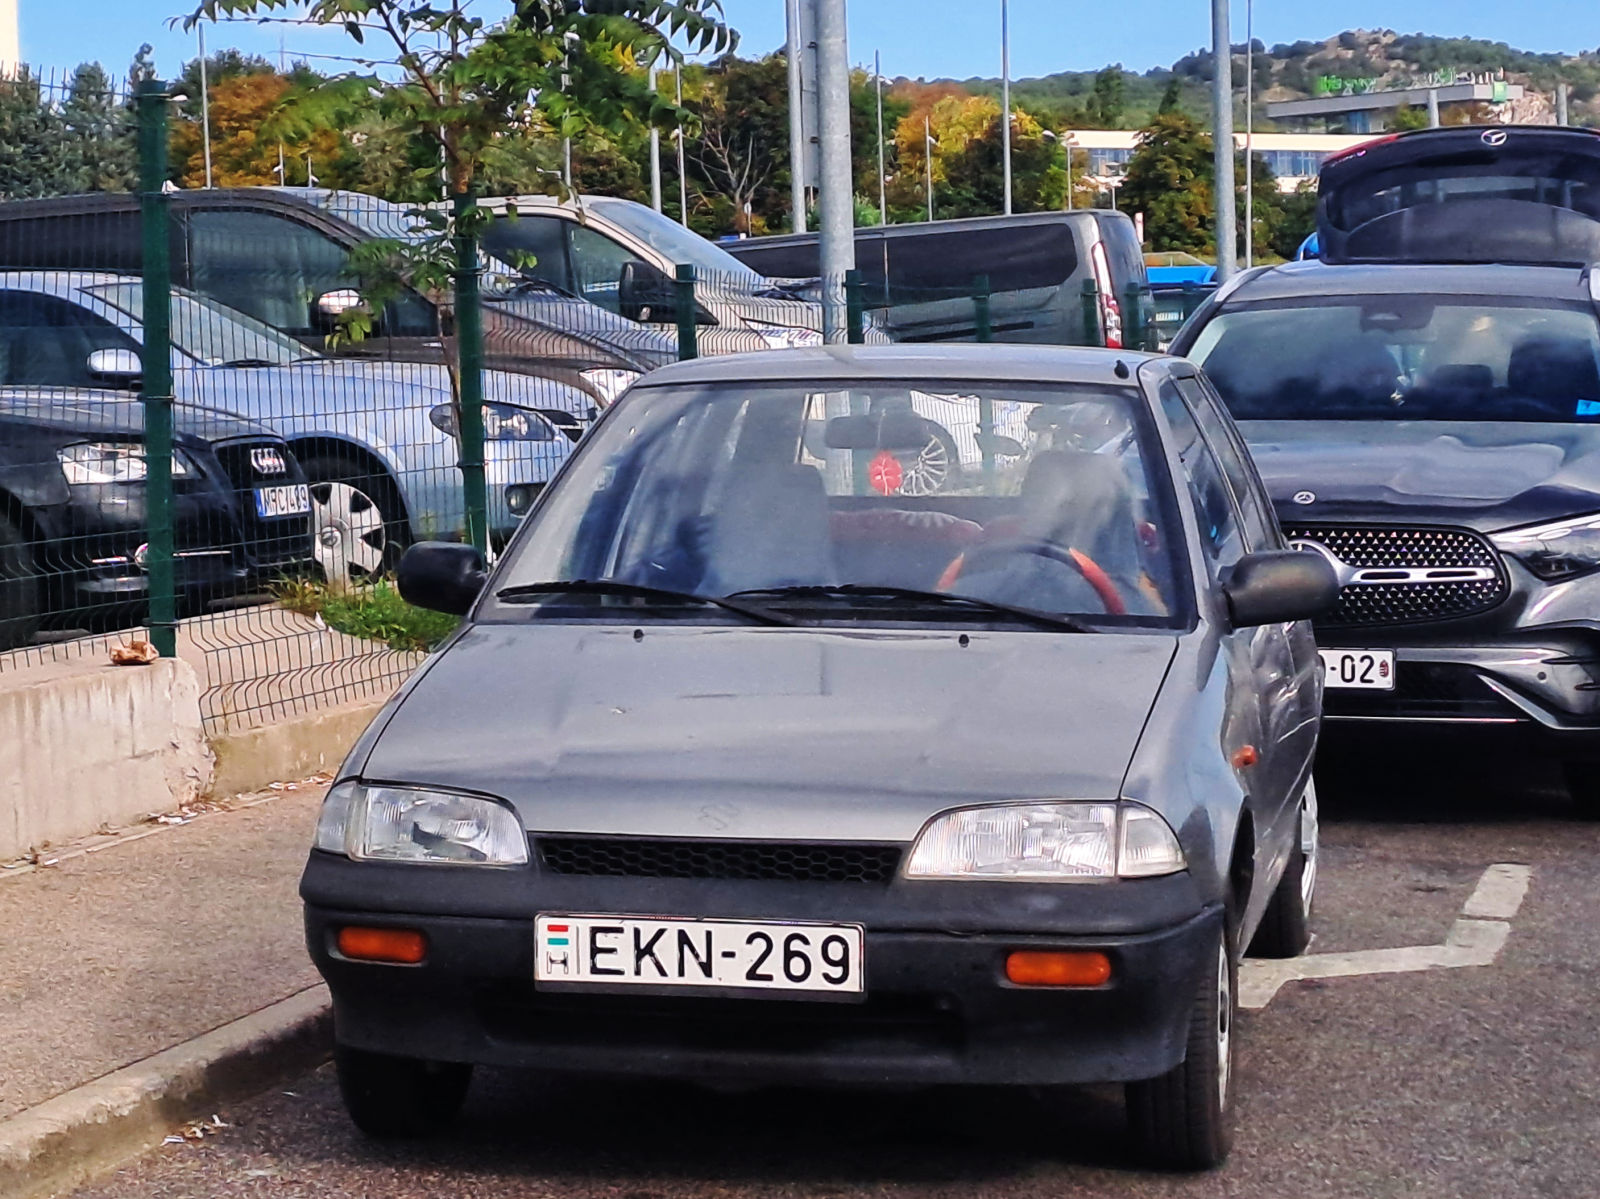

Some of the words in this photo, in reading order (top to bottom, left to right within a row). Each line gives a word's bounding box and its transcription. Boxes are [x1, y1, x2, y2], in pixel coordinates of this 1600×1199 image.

[1321, 654, 1375, 684] -02
[547, 951, 569, 975] H
[589, 926, 850, 985] EKN-269
